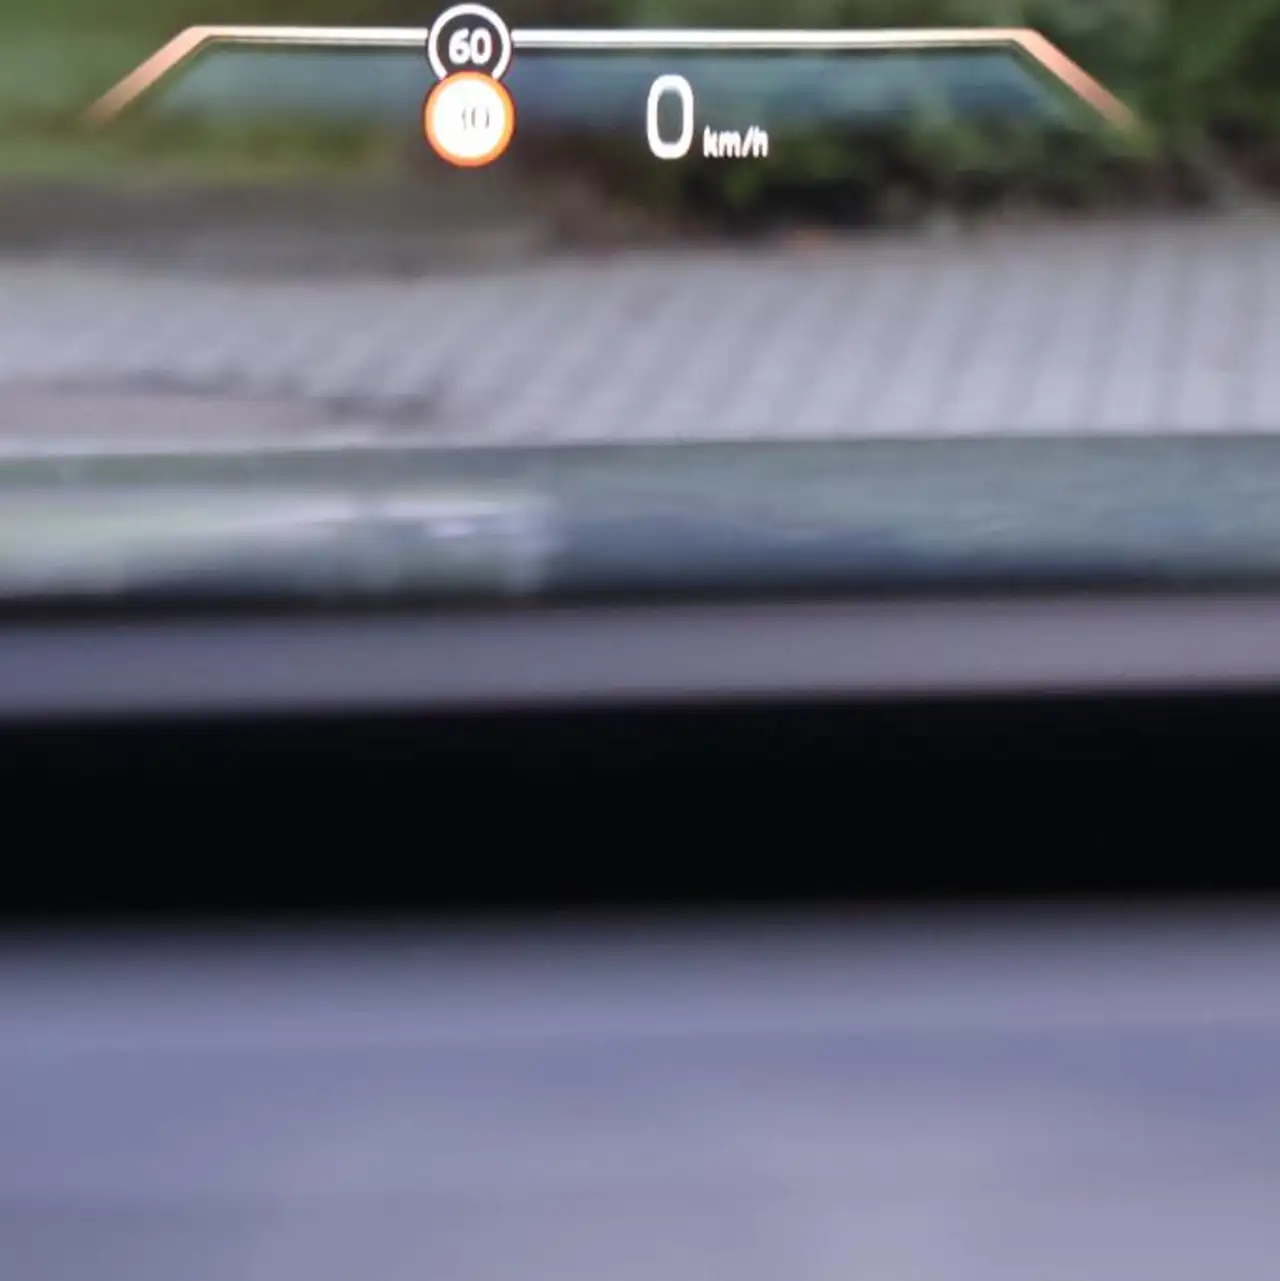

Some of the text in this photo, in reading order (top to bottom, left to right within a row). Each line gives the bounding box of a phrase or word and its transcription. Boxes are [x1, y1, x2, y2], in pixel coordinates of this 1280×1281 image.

[448, 27, 492, 65] 60
[646, 74, 769, 160] 0 km/h
